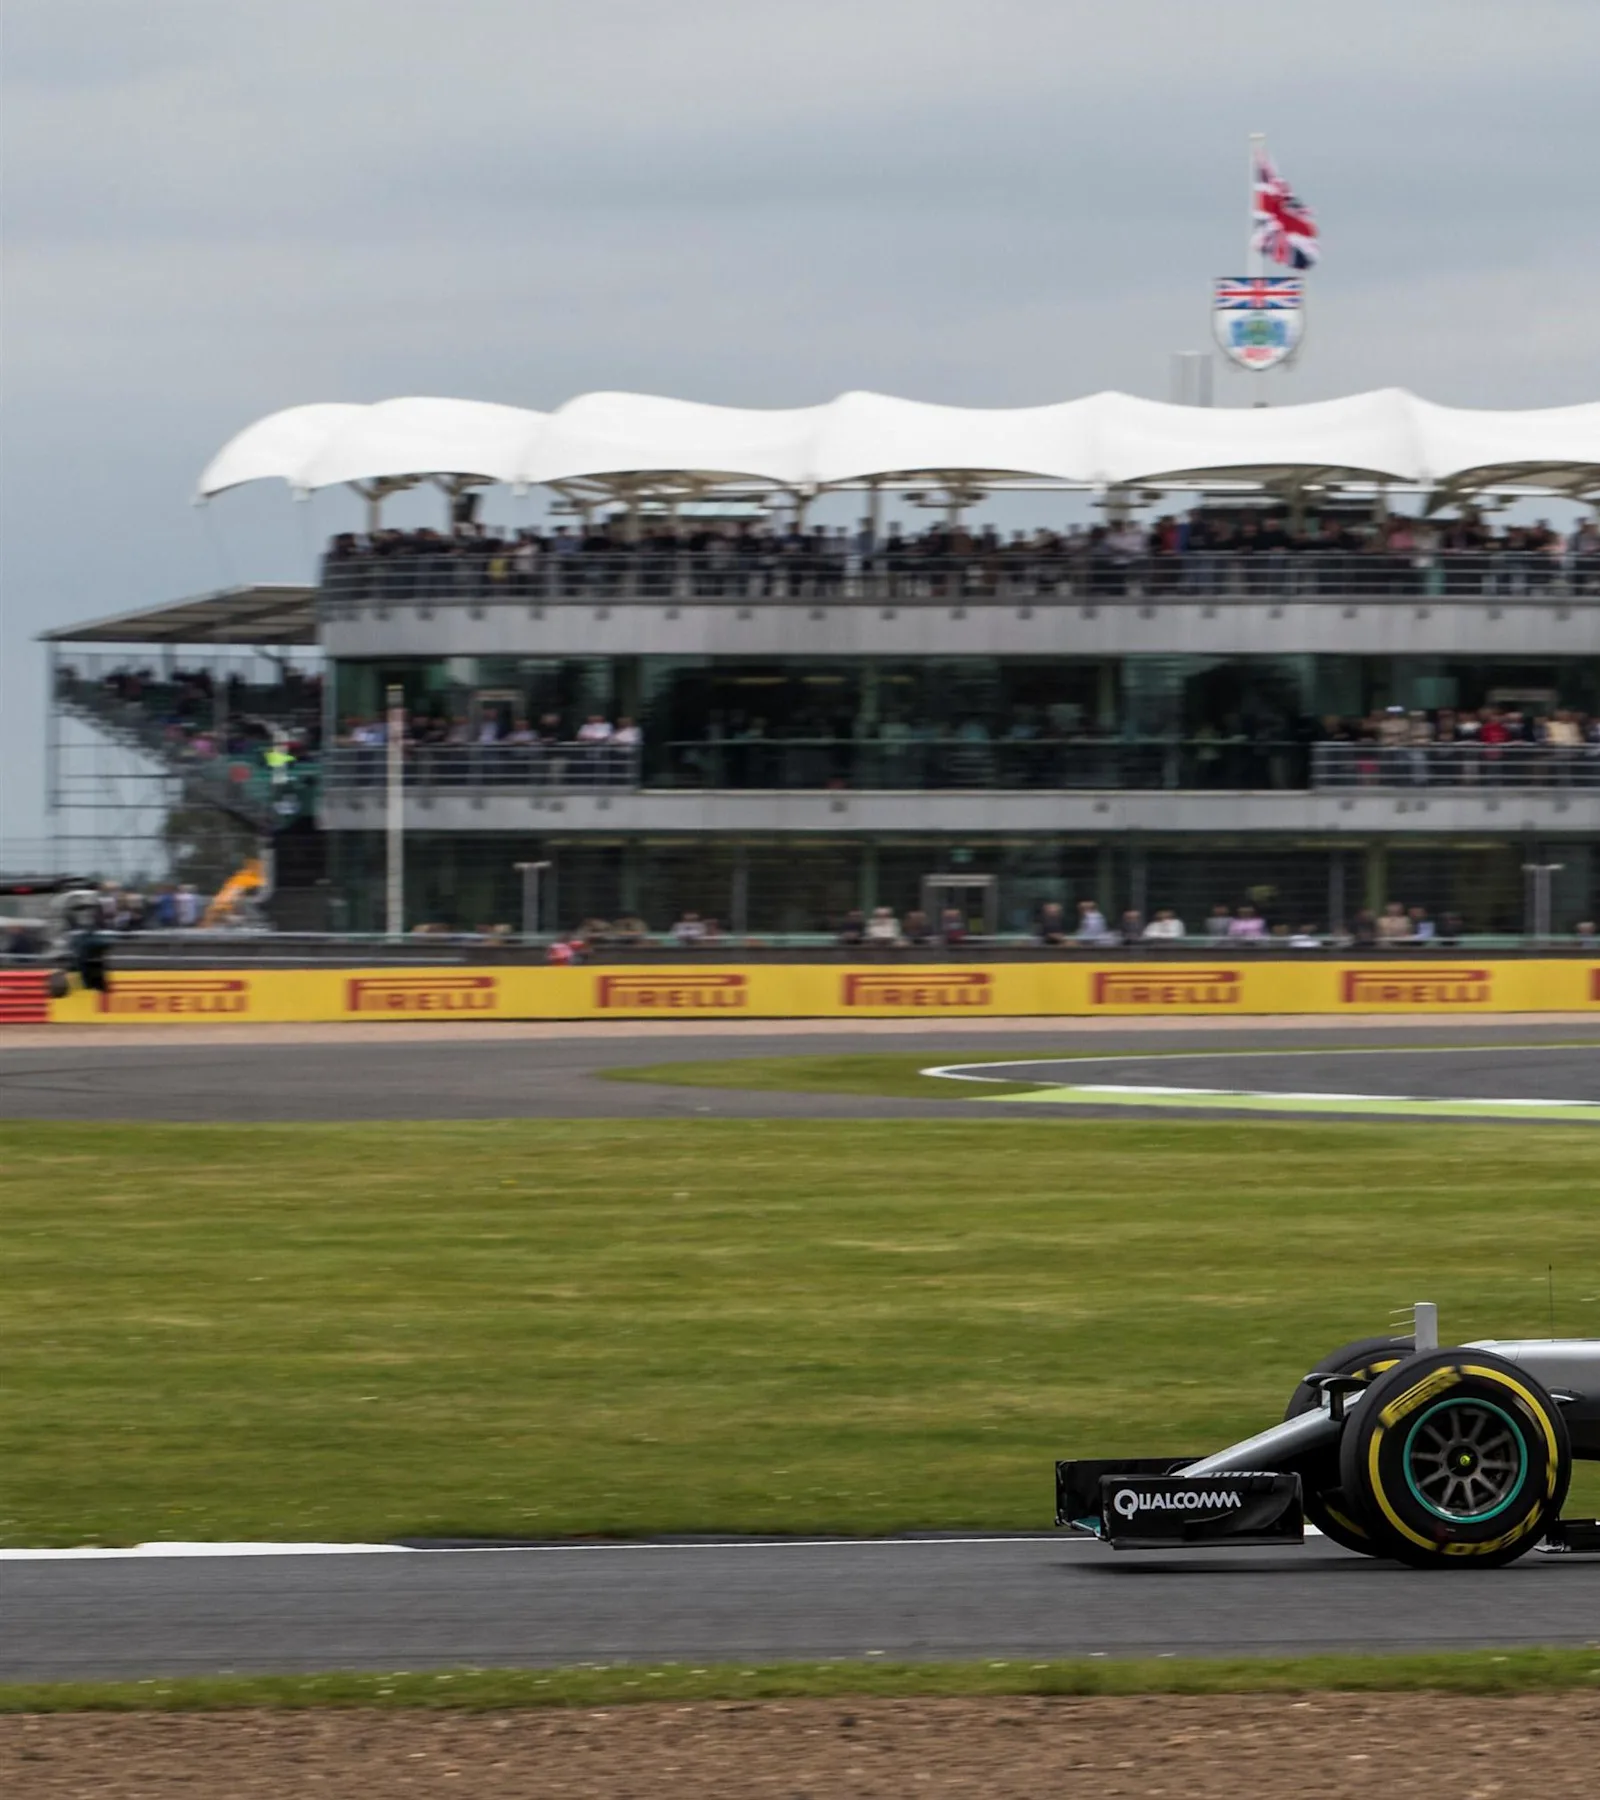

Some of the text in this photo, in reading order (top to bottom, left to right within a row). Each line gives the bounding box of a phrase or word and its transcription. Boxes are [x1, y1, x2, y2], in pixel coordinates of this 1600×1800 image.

[346, 976, 496, 1011] PIRELLI
[597, 973, 746, 1007] PIRELLI
[844, 972, 992, 1005] PIRELLI
[1092, 972, 1241, 1005] PIRELLI
[1341, 969, 1491, 1002] PIRELLI
[1114, 1489, 1242, 1519] QUALCOMM
